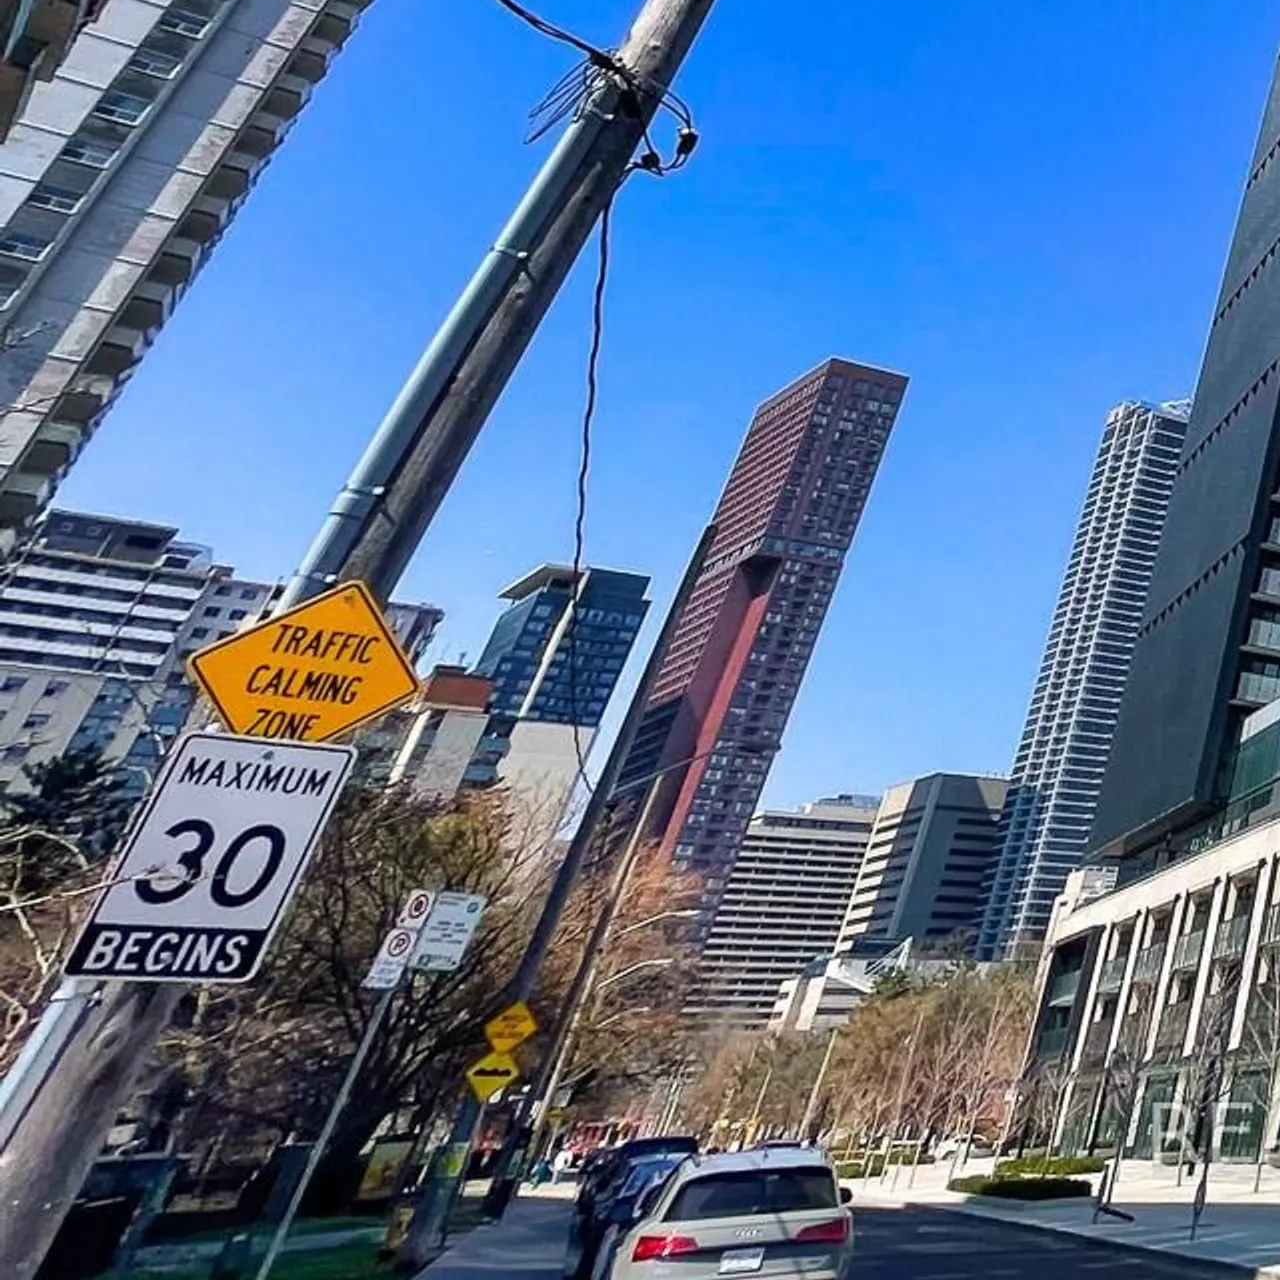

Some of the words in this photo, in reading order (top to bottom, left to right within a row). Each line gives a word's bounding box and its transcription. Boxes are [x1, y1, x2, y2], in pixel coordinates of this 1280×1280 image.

[271, 624, 381, 664] TRAFFIC
[246, 665, 363, 705] CALMING
[245, 709, 321, 741] ZONE
[178, 756, 331, 797] MAXIMUM
[134, 819, 286, 908] 30
[82, 930, 249, 973] BEGINS
